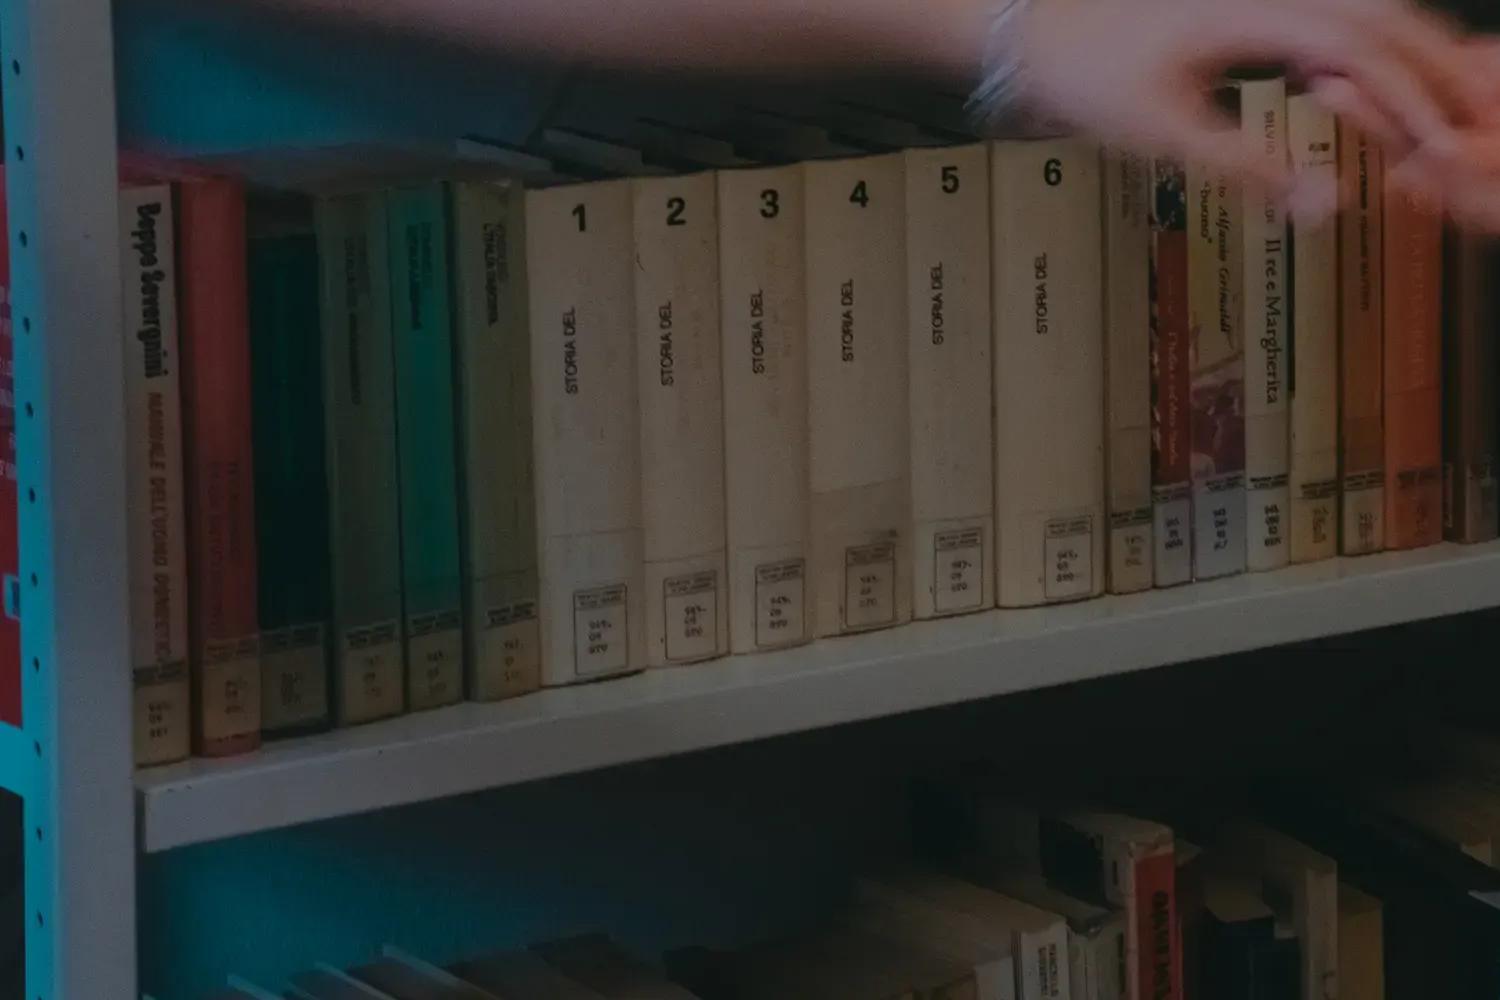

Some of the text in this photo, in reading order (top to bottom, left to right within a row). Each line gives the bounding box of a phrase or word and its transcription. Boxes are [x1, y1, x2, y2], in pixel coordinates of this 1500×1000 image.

[941, 166, 960, 194] 5
[1043, 158, 1063, 186] 6
[760, 190, 779, 218] 3
[849, 181, 869, 207] 4
[572, 205, 586, 231] 1
[666, 198, 686, 226] 2
[1264, 239, 1281, 252] Il
[1265, 258, 1278, 275] re
[1035, 252, 1049, 335] STORIA DEL
[1265, 280, 1277, 292] e
[931, 262, 945, 346] STORIA DEL
[751, 288, 766, 375] STORIA DEL
[842, 278, 855, 363] STORIA DEL
[564, 305, 579, 395] STORIA DEL
[659, 301, 674, 387] STORIA DEL
[1259, 295, 1283, 404] Margherita
[131, 203, 172, 662] Beppe Severgnini MANUALE DELL'UOMO DOMESTIC
